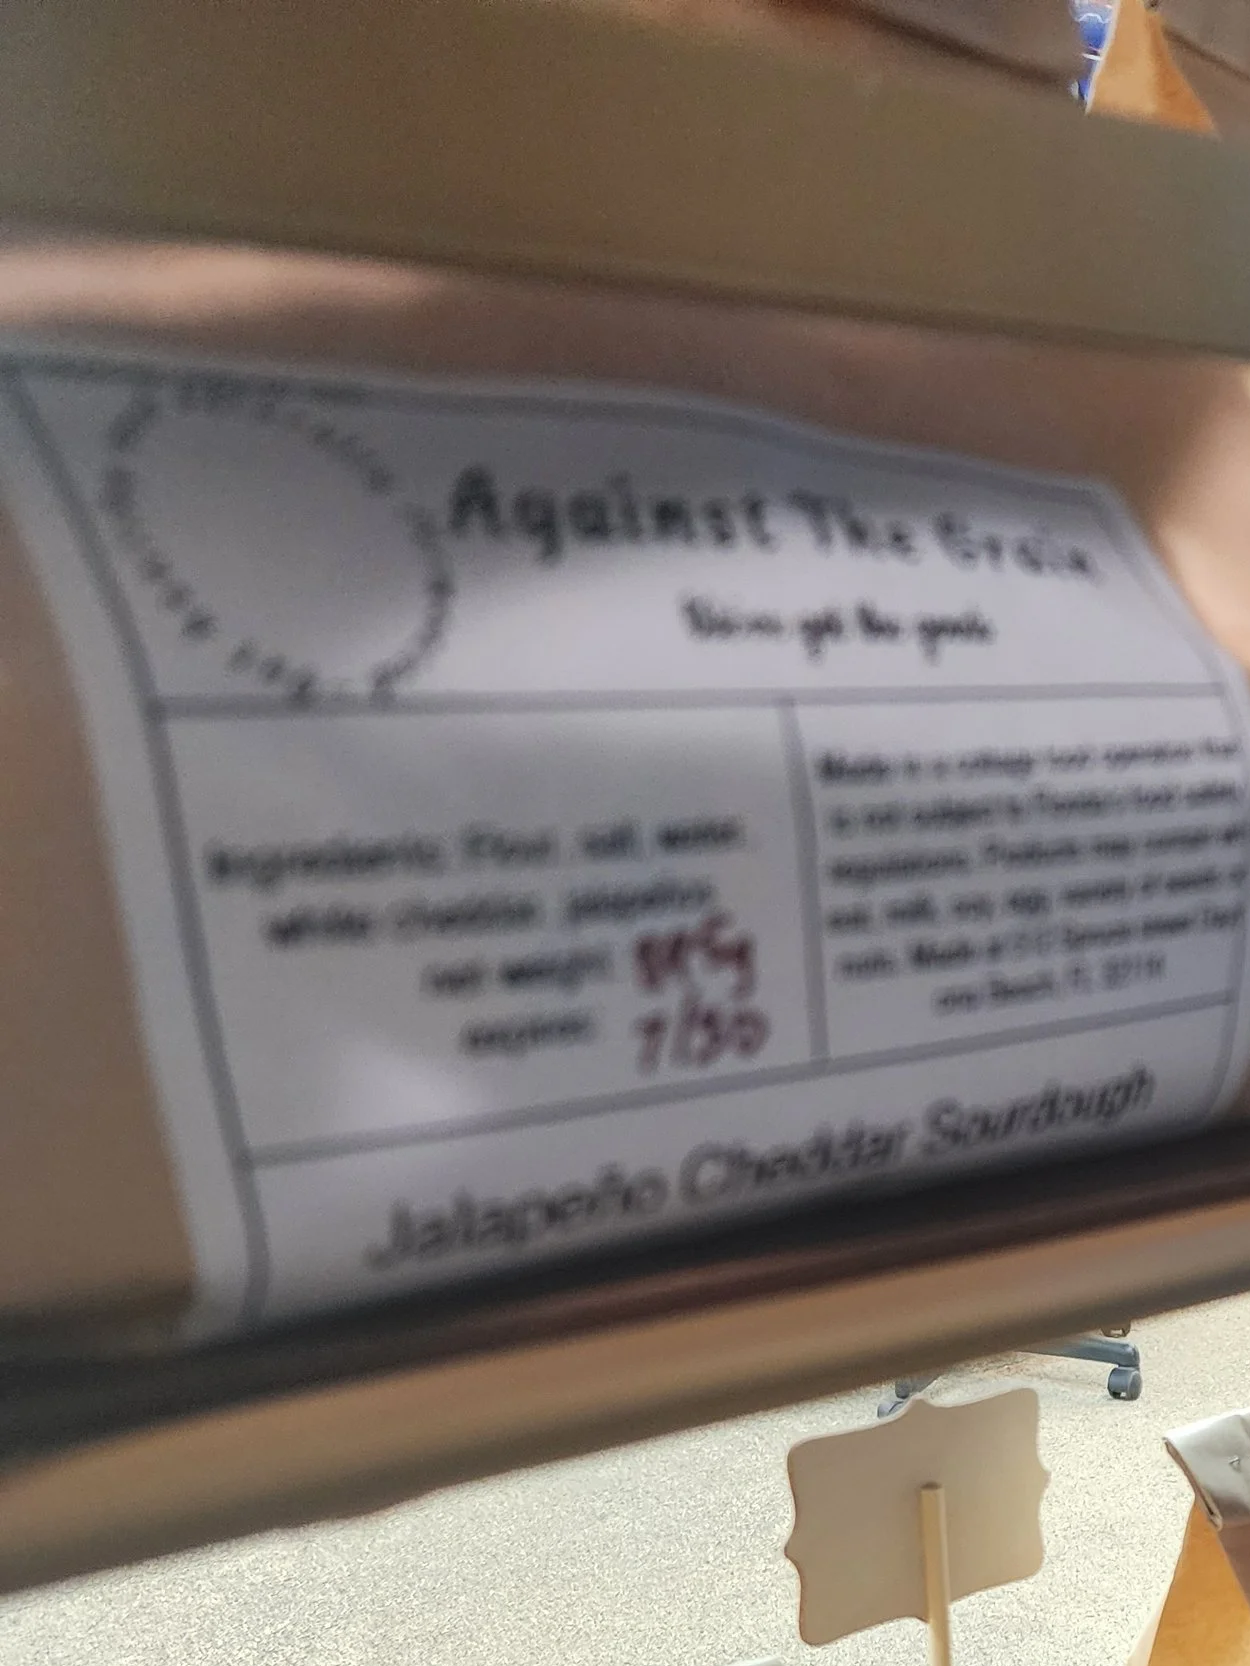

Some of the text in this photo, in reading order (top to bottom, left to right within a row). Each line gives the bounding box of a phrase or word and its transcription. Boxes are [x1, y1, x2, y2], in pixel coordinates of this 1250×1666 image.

[448, 463, 776, 569] Against
[785, 490, 918, 562] The
[678, 1118, 910, 1206] Cheddar
[920, 1060, 1157, 1152] Sourdough
